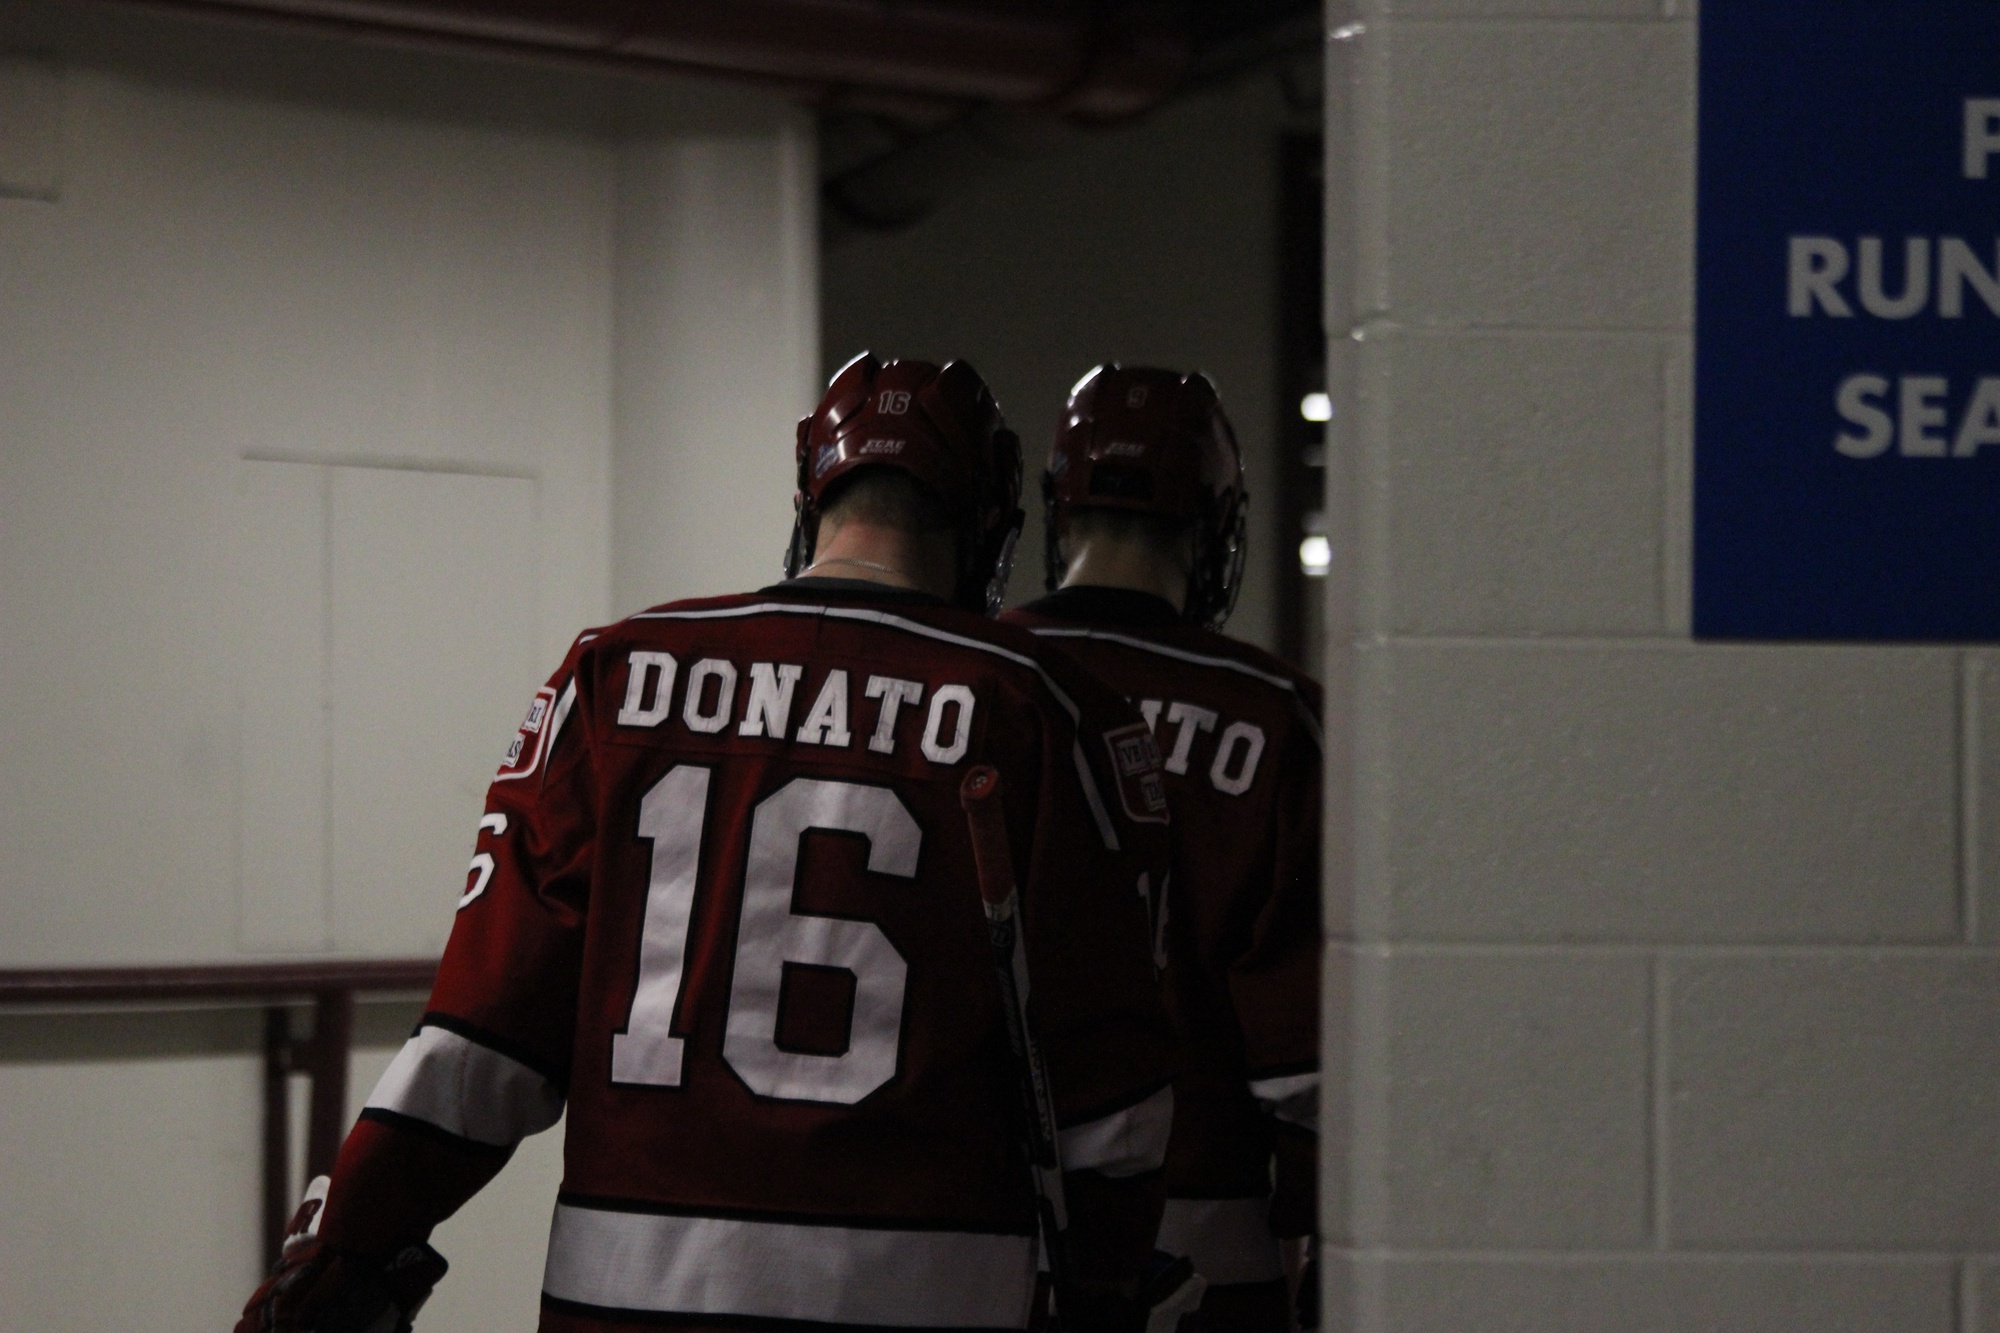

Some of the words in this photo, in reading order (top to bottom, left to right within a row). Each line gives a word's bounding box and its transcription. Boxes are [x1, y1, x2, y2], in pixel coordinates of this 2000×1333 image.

[1787, 235, 2000, 319] RUN
[878, 390, 911, 415] 16
[1833, 373, 2000, 459] SEA
[617, 650, 976, 765] DONATO
[611, 763, 924, 1106] 16
